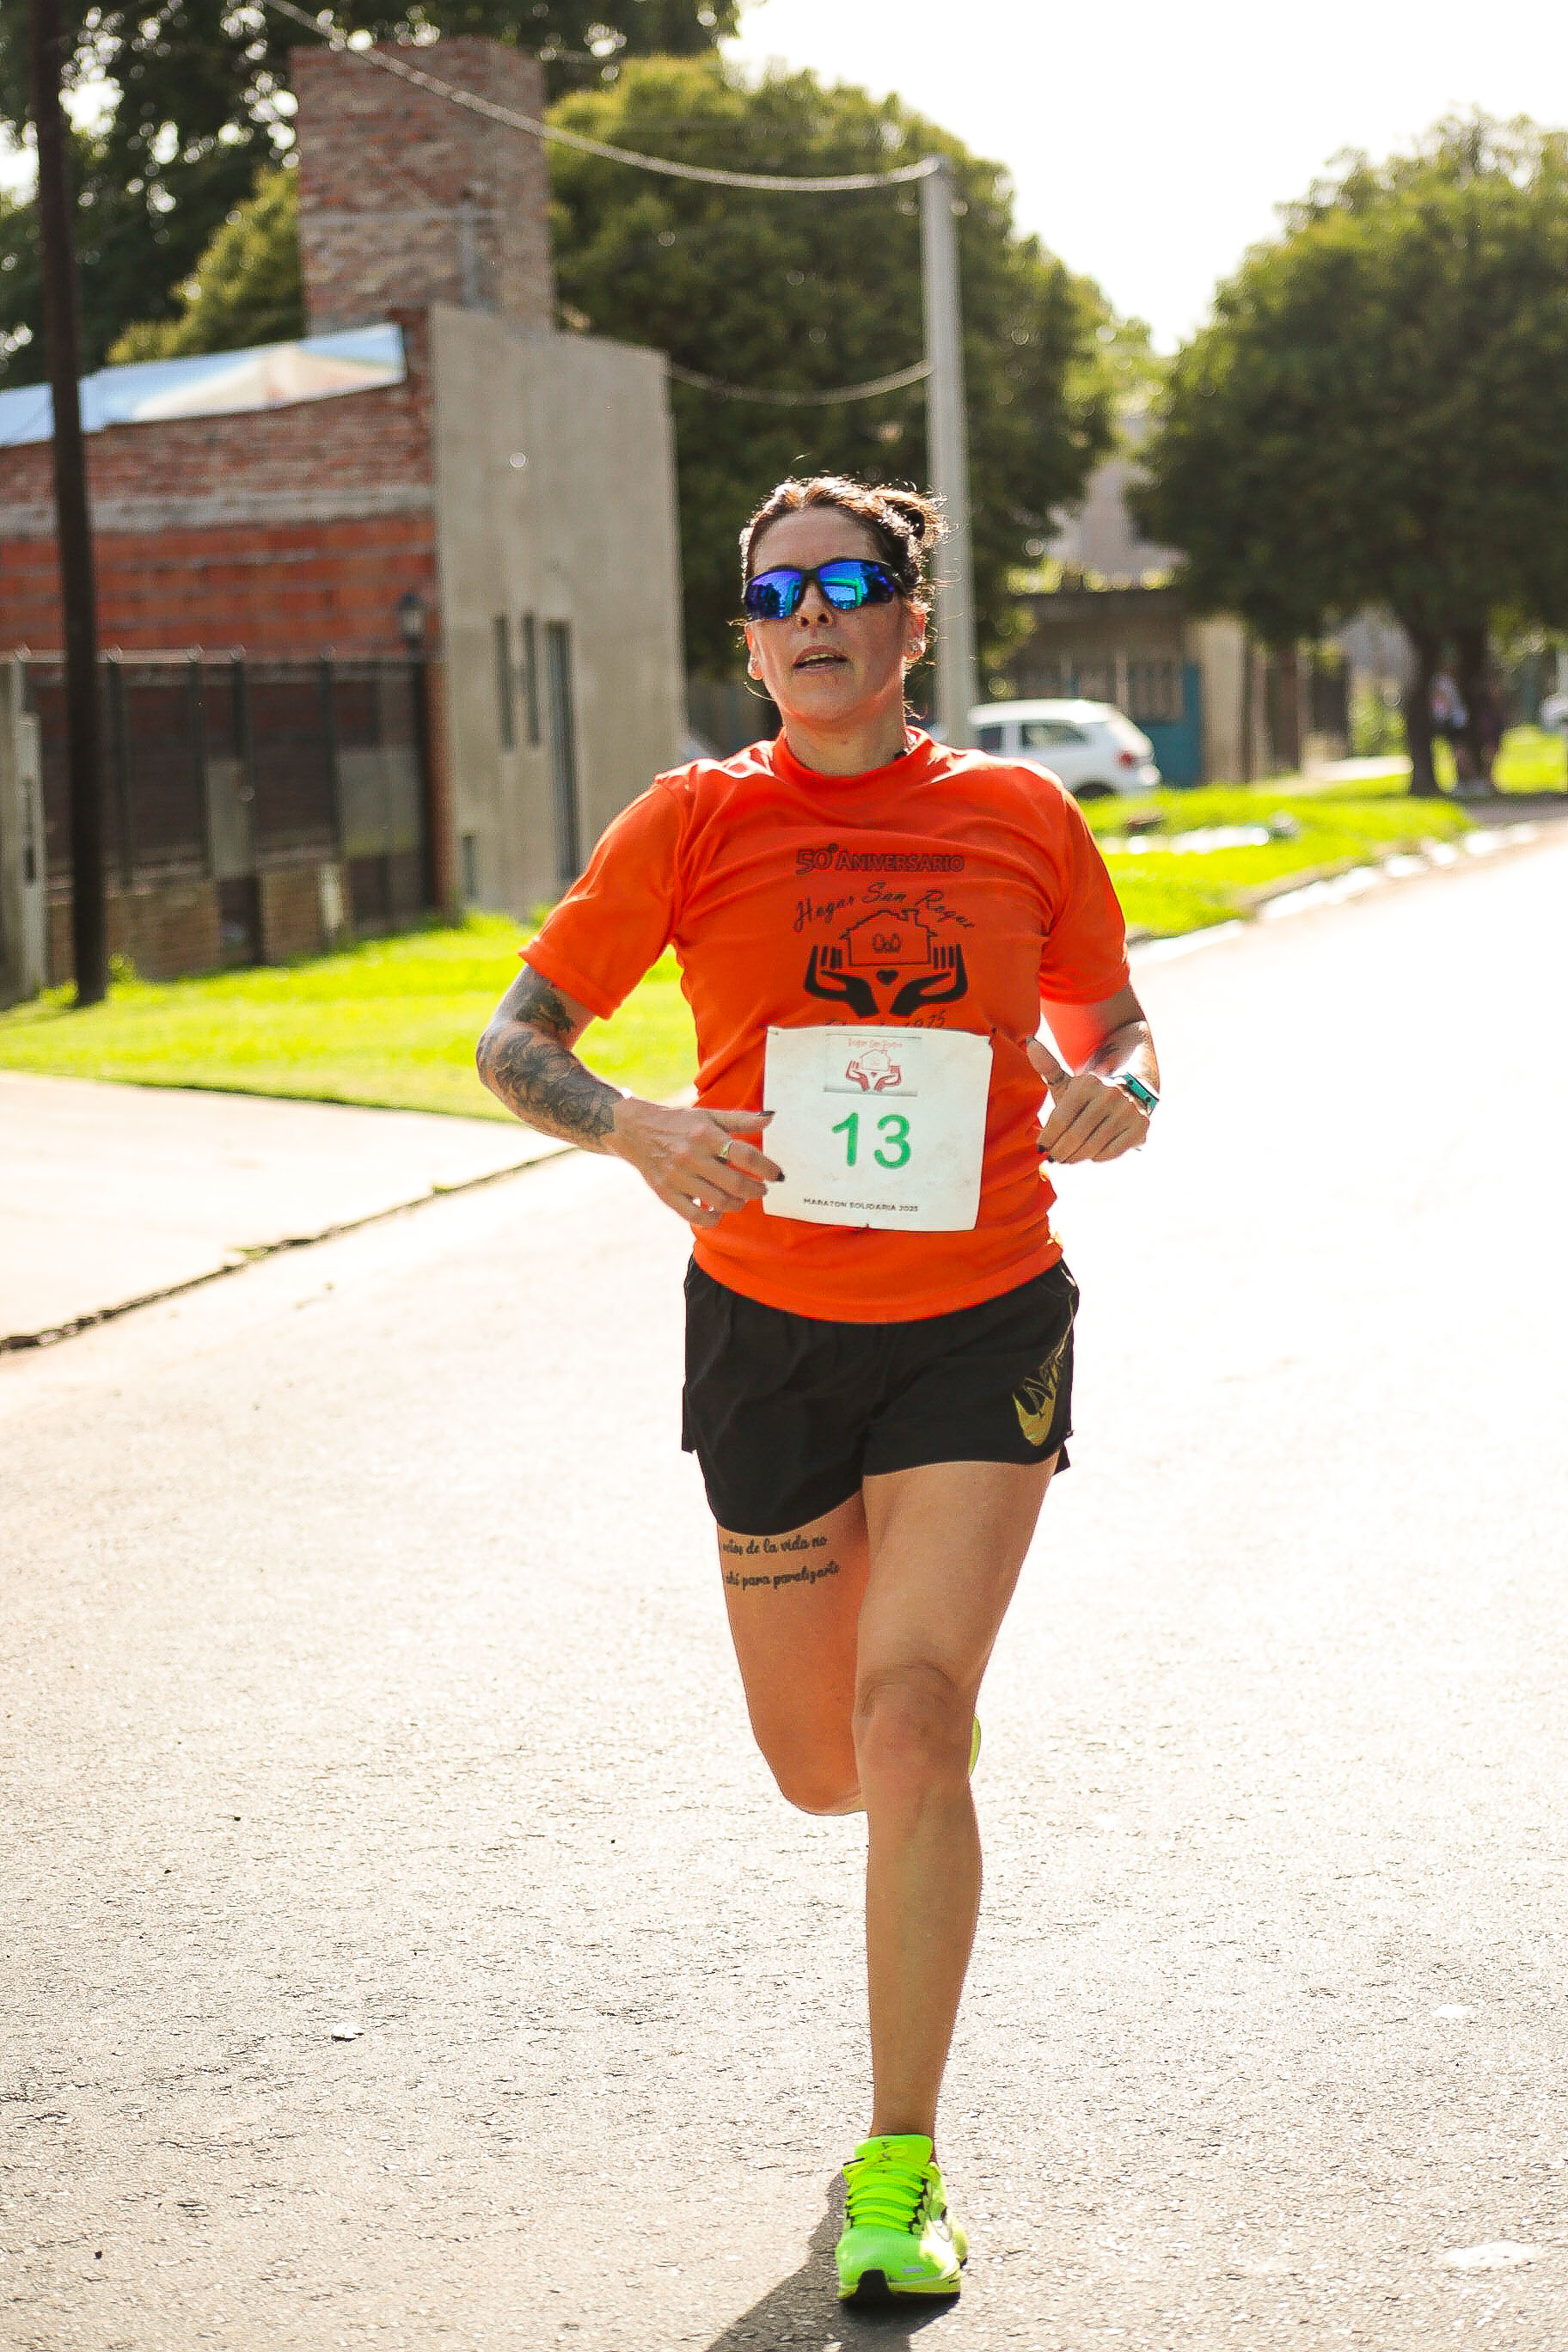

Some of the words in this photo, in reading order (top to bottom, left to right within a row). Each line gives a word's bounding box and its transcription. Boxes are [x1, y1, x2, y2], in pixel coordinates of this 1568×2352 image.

[861, 882, 907, 903] San
[831, 1112, 911, 1169] 13
[746, 1540, 759, 1554] de
[763, 1538, 778, 1553] la
[781, 1534, 809, 1552] vida
[812, 1535, 829, 1548] no
[742, 1576, 771, 1590] para
